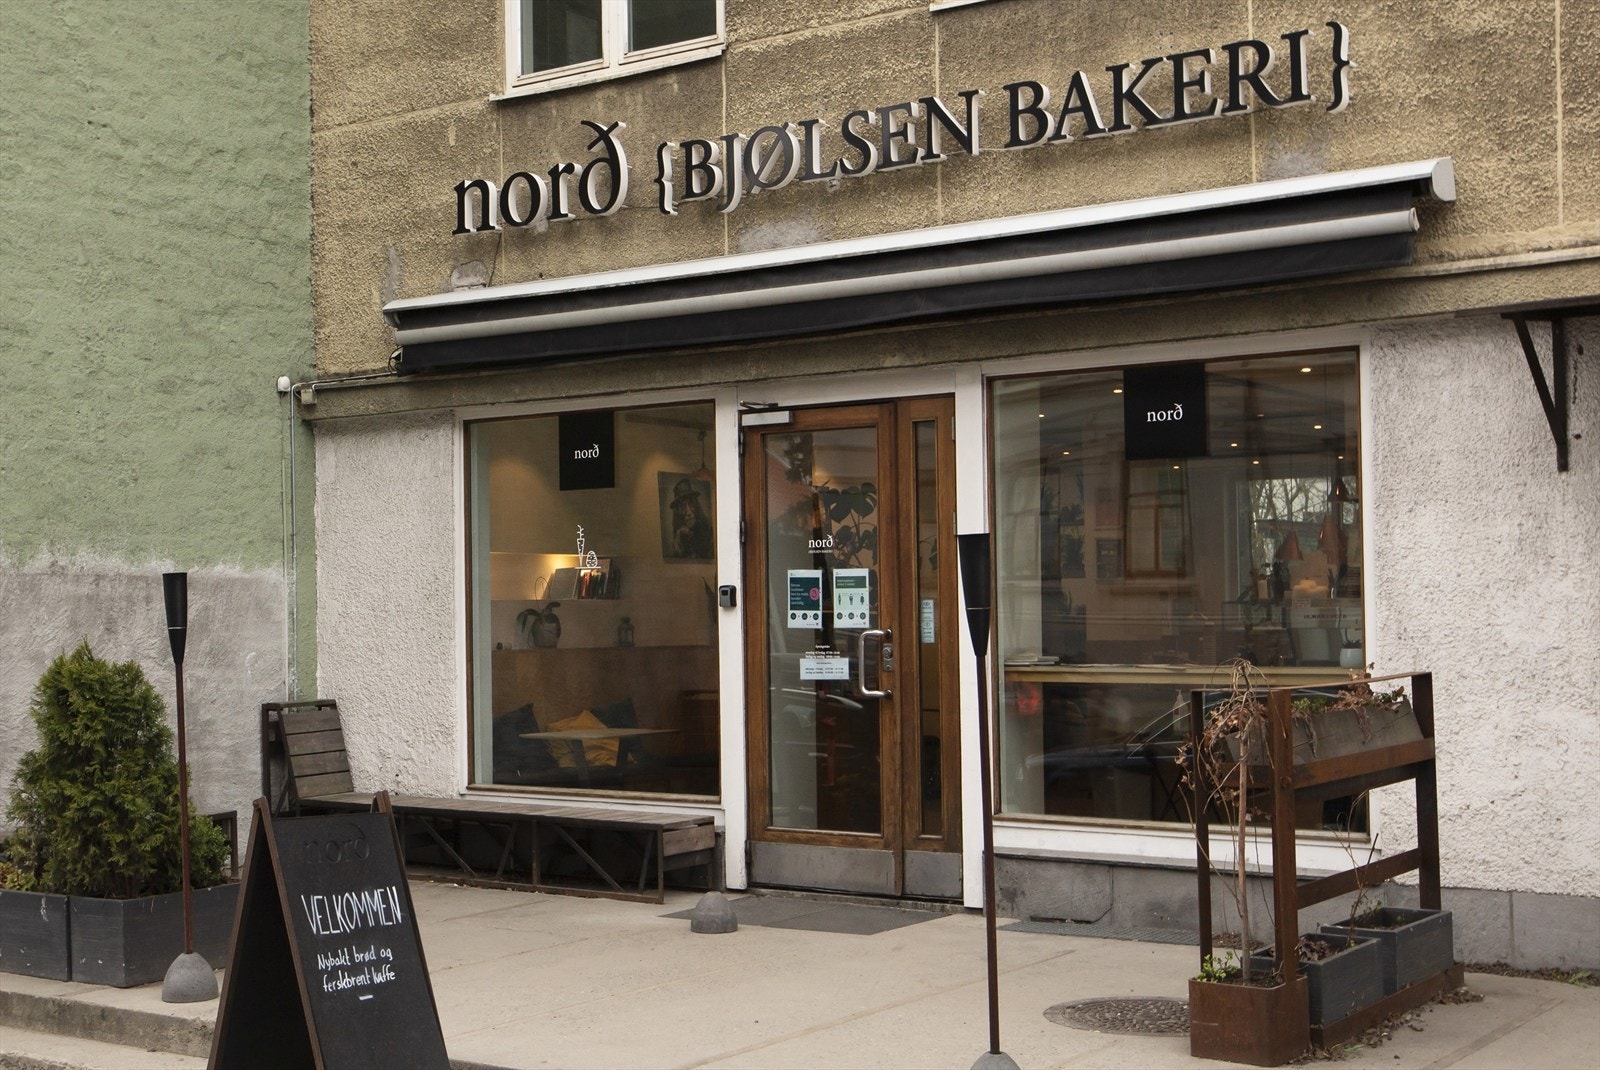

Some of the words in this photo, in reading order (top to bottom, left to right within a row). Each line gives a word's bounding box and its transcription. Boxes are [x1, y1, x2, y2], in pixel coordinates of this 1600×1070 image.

[452, 120, 627, 235] norð
[1146, 403, 1183, 422] norð
[574, 443, 600, 459] norð
[808, 534, 833, 548] norð
[300, 886, 403, 935] VELKOMMEN
[317, 947, 351, 971] Nybakt
[353, 945, 377, 963] brød
[380, 947, 392, 961] og
[322, 970, 371, 992] ferskbrent
[371, 964, 396, 986] kaffe
